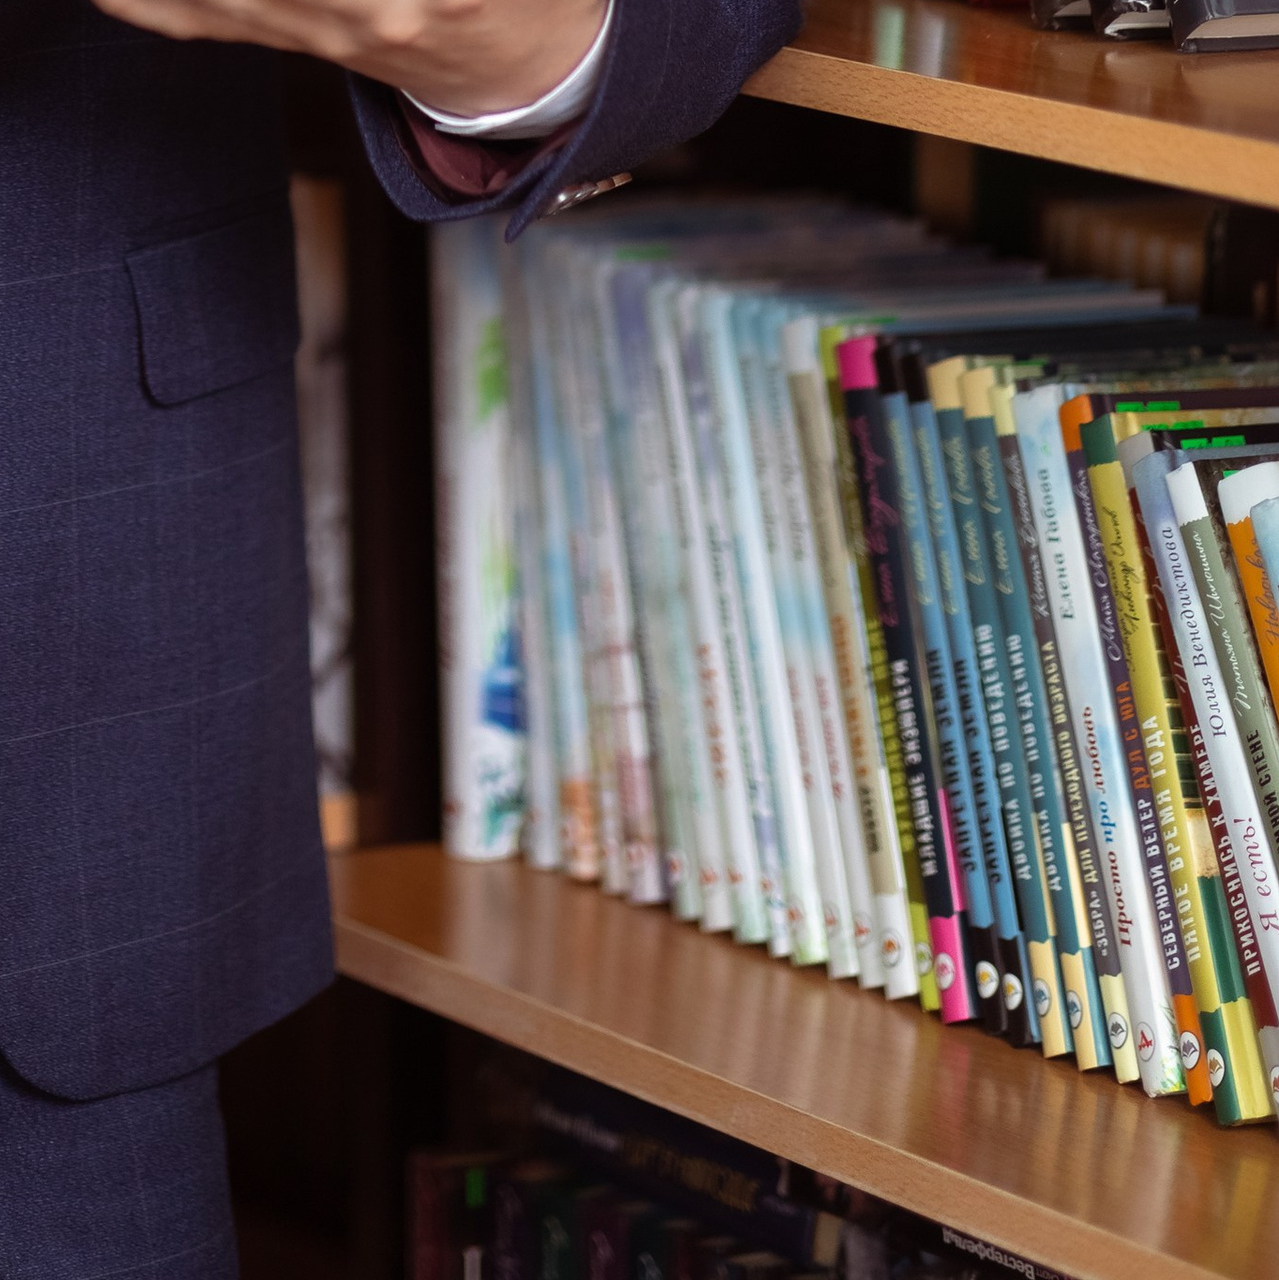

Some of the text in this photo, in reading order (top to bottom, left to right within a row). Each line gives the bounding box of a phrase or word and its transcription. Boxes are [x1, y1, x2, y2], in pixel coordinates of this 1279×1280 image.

[1035, 467, 1076, 621] Елена Габова
[1157, 526, 1211, 667] Венедиктова
[1006, 633, 1042, 762] ПОВЕДЕНИЮ
[1195, 675, 1228, 738] Юлия
[1217, 627, 1252, 717] Татьяна
[975, 623, 1031, 881] ДВОЙКА ПО ПОВЕДЕНИЮ
[1025, 771, 1046, 799] ПО
[1040, 639, 1110, 957] «ЗЕБРА» ДЛЯ ПЕРЕХОДНОГО ВОЗРАСТА
[1142, 714, 1168, 778] ГОДА
[1246, 729, 1273, 787] СТЕНЕ
[908, 772, 938, 877] МЛАДШИЕ
[1081, 704, 1133, 947] Просто про любовь
[1118, 679, 1182, 971] СЕВЕРНЫЙ ВЕТЕР ДУЛ С ЮГА
[1155, 788, 1185, 873] ВРЕМЯ
[1213, 813, 1230, 827] К
[1169, 881, 1203, 963] ПЯТОЕ
[1216, 835, 1262, 976] ПРИКОСНИСЬ
[1232, 815, 1279, 935] Я есть!
[941, 1226, 1036, 1280] Вестерфельд
